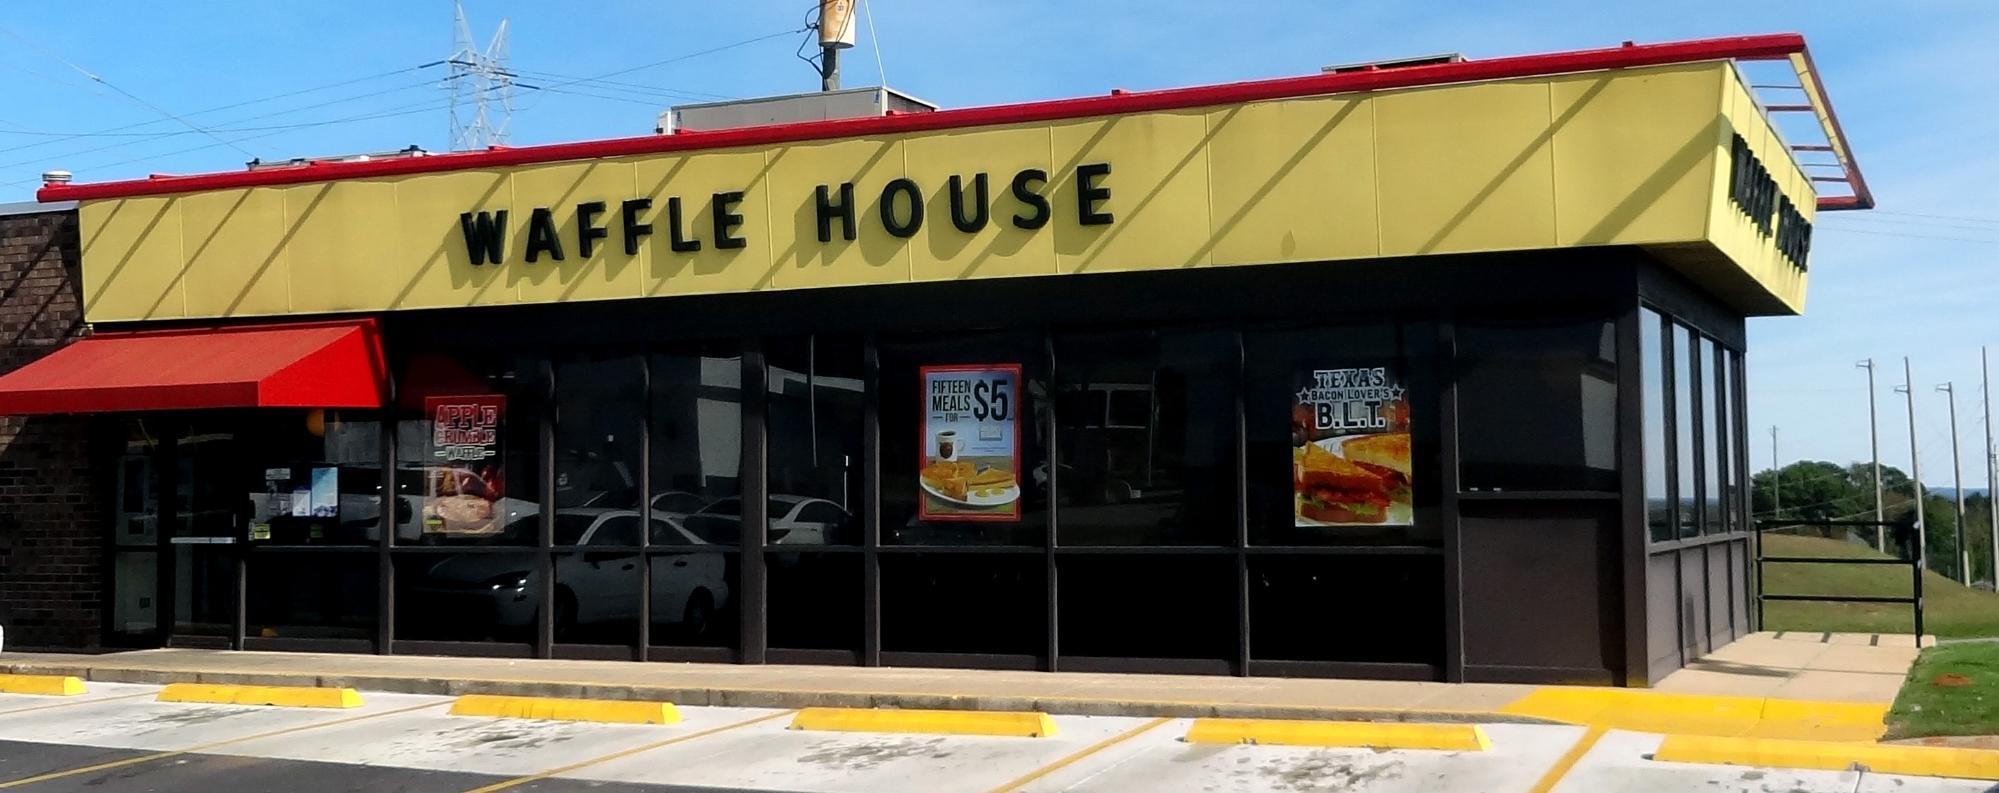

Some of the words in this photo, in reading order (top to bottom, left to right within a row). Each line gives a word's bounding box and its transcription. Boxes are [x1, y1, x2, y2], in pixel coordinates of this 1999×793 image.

[460, 191, 747, 265] WAFFLE
[815, 163, 1114, 243] HOUSE
[932, 379, 971, 394] FIFTEEN
[1314, 367, 1385, 389] TEXAS
[932, 395, 970, 412] MEALS
[973, 379, 1008, 422] $5
[1311, 390, 1344, 401] BACON
[1347, 388, 1390, 400] LOVER'S
[435, 404, 497, 429] APPLE
[945, 413, 959, 423] FOR
[1315, 400, 1386, 429] B.L.T.
